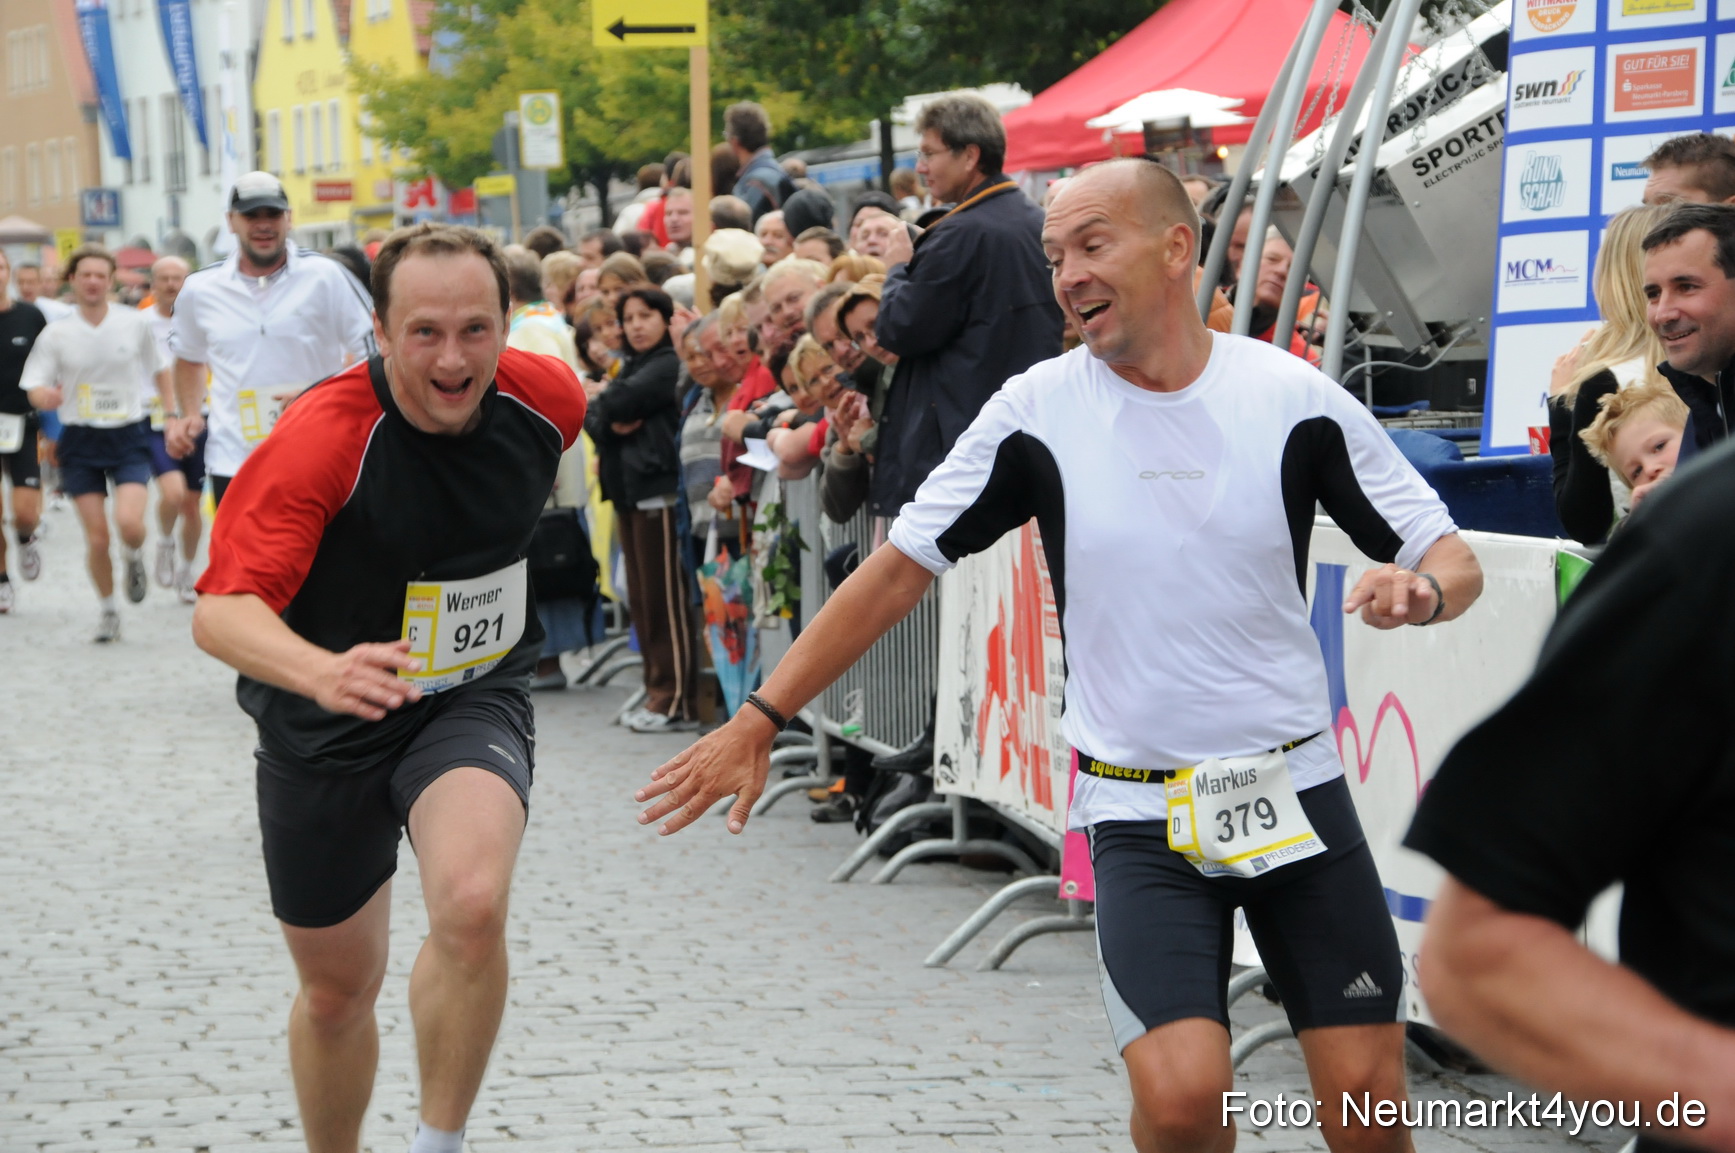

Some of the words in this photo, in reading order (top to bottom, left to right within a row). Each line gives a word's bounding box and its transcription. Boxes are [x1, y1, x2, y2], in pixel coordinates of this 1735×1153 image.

[1623, 59, 1645, 71] GUT
[1647, 55, 1667, 68] FÜR
[1671, 54, 1690, 66] SIE!
[1515, 80, 1558, 101] swn
[1632, 82, 1662, 91] Sparkasse
[1521, 150, 1562, 184] RUND
[1520, 181, 1567, 210] SCHAU
[1506, 258, 1552, 281] MCM
[1138, 470, 1206, 480] orca
[446, 587, 502, 613] Werner
[408, 626, 418, 642] C
[453, 612, 504, 653] 921
[1089, 759, 1151, 783] squeezy
[1195, 767, 1257, 797] Markus
[1173, 817, 1181, 834] D
[1215, 797, 1278, 843] 379
[1264, 838, 1320, 862] PFLEIDERER
[1342, 986, 1383, 999] adidas
